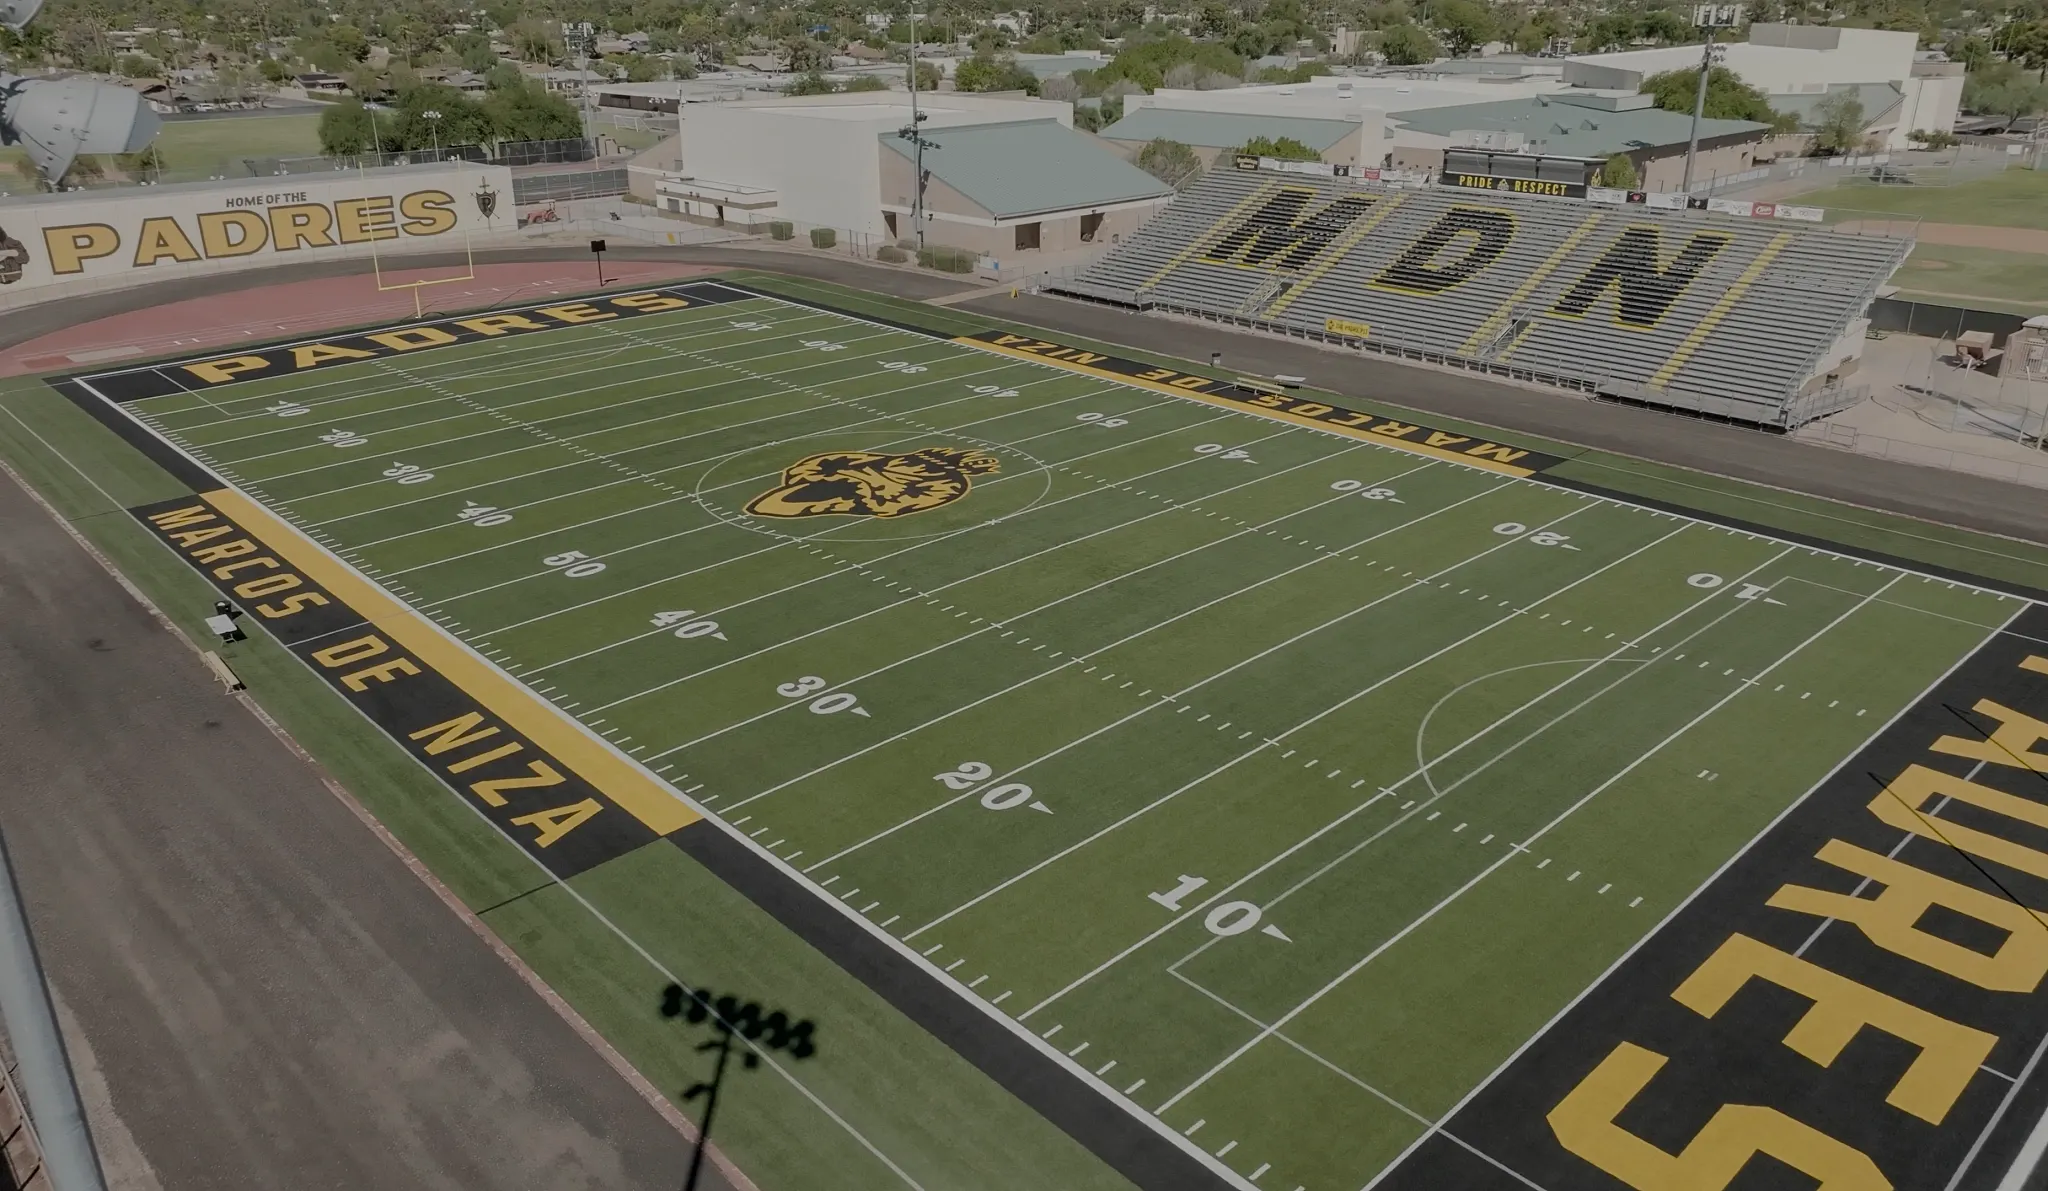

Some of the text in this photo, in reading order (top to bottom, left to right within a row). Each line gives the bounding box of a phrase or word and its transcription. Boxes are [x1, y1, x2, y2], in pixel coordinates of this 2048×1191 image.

[1459, 175, 1568, 196] PRIDE RESPECT
[226, 191, 307, 208] HOME OF THE
[42, 190, 457, 275] PADRES
[180, 295, 689, 384] PADRES
[265, 401, 310, 417] 10
[993, 334, 1530, 463] MARCOS DE NIZA
[1076, 412, 1129, 428] 50
[318, 431, 369, 448] 20
[1193, 443, 1252, 461] 40
[382, 464, 435, 485] 30
[1330, 479, 1398, 500] 30
[456, 506, 513, 528] 40
[1492, 522, 1572, 546] 20
[543, 550, 607, 578] 50
[1686, 572, 1771, 601] 10
[649, 609, 720, 639] 40
[148, 505, 604, 849] MARCOS DE NIZA
[776, 675, 858, 715] 30
[933, 761, 1034, 811] 20
[1147, 874, 1263, 937] 10
